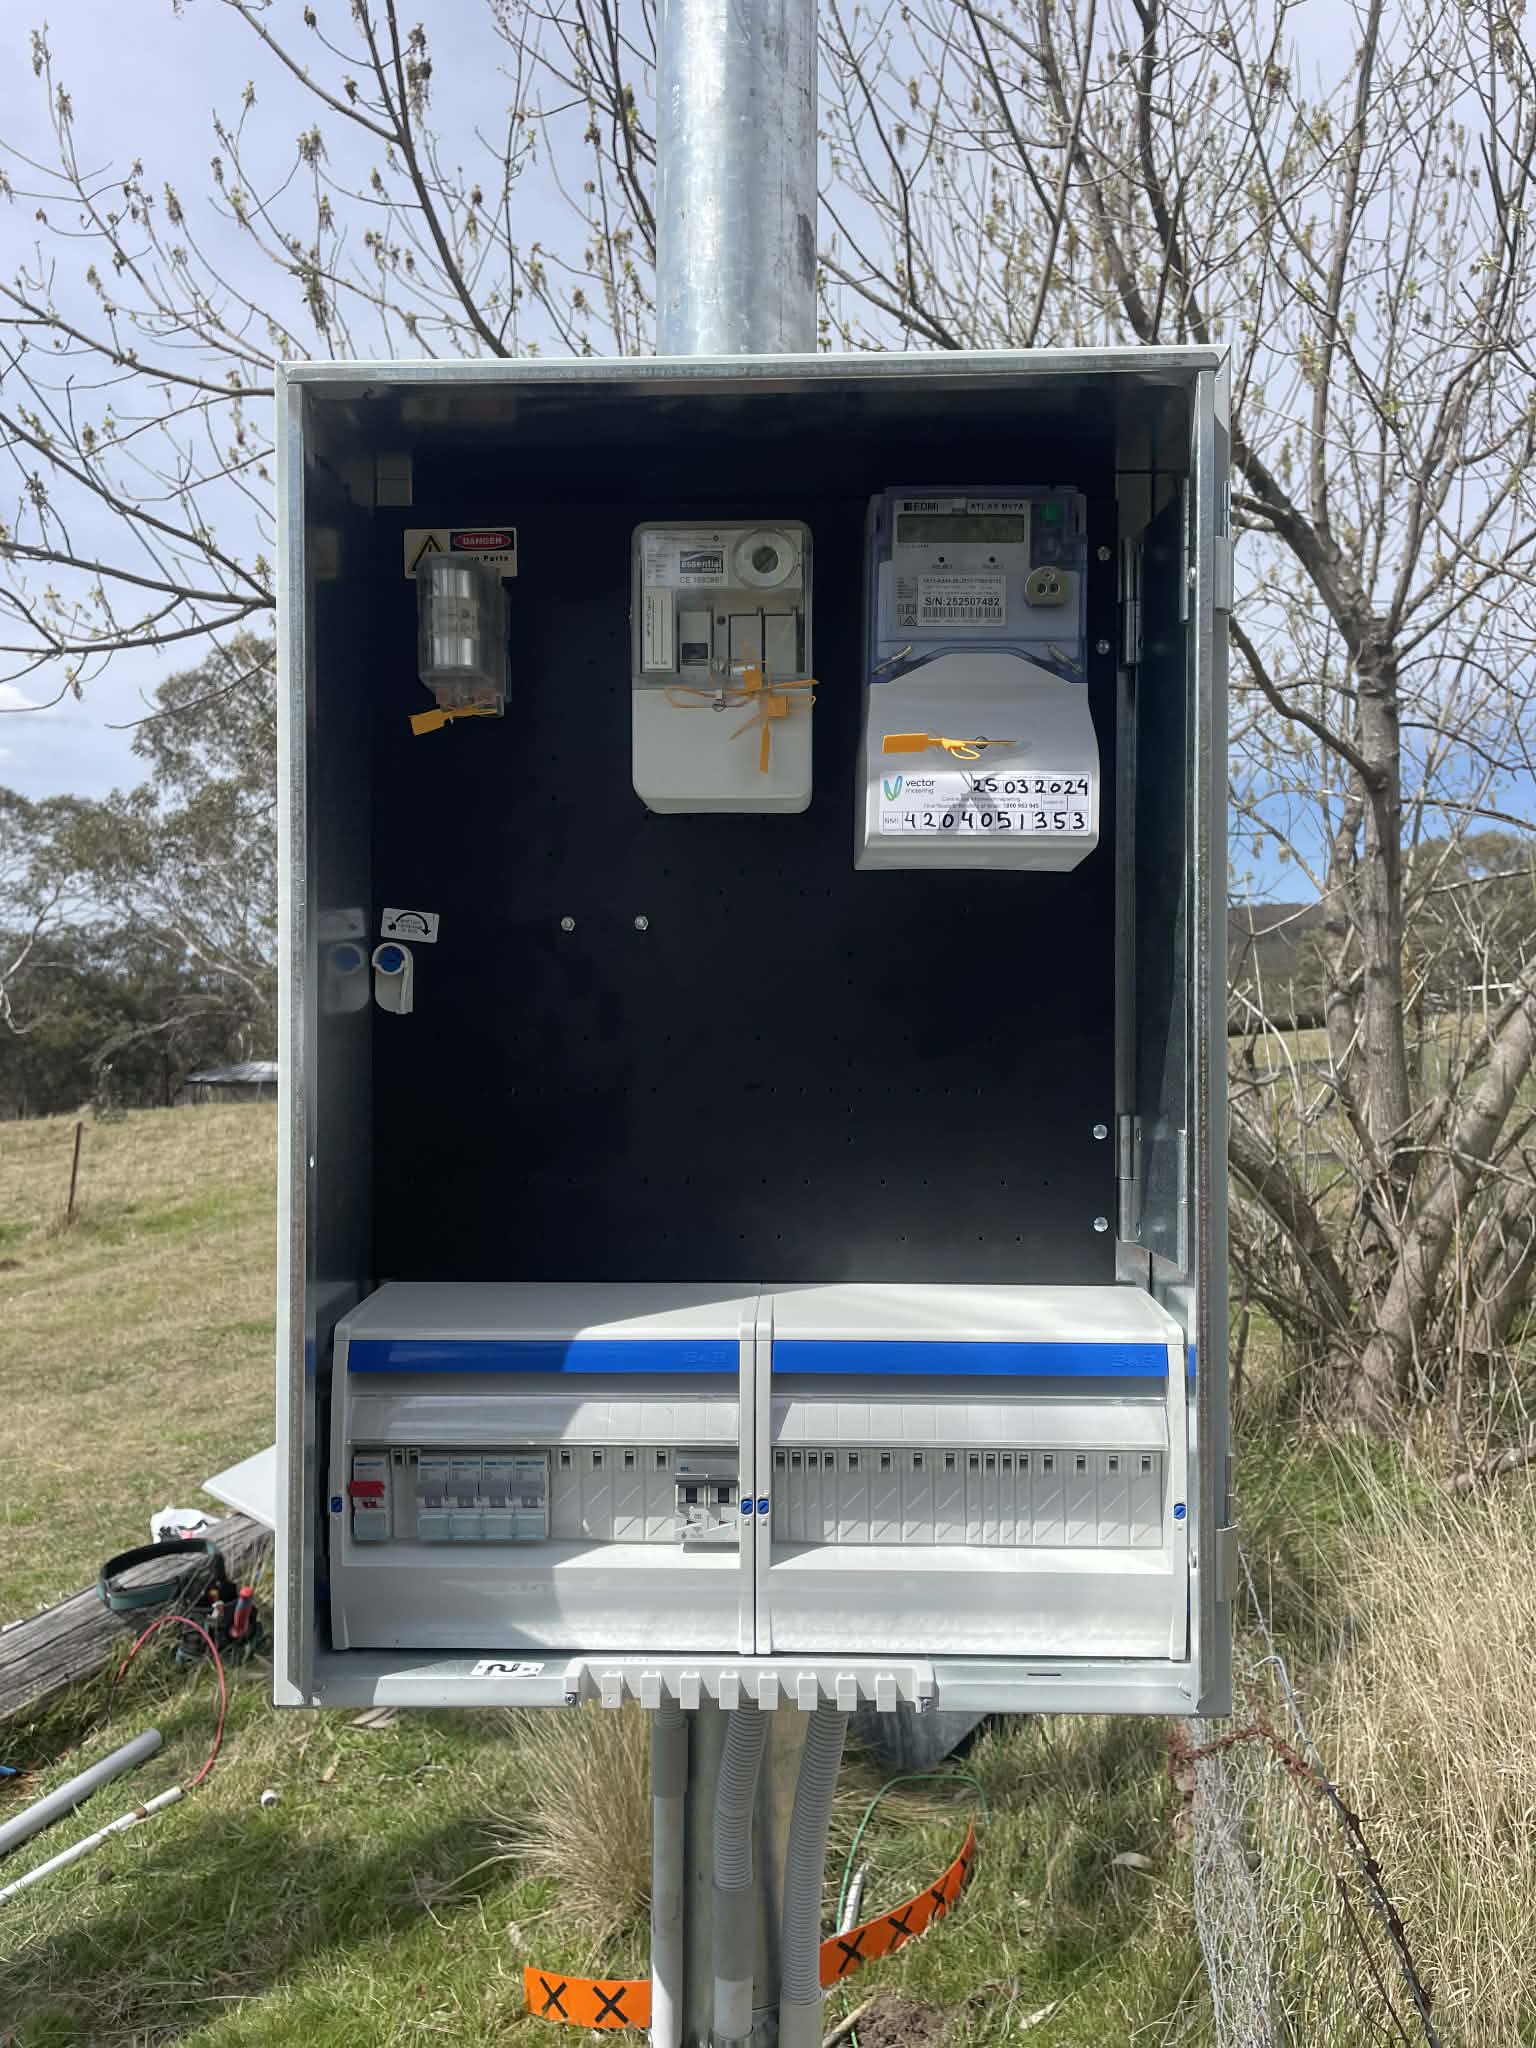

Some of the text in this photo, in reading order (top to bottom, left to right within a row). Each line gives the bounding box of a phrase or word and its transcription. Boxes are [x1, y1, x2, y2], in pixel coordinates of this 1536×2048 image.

[913, 502, 938, 512] EDMI
[463, 537, 503, 545] DANGER
[680, 558, 722, 569] essential
[905, 778, 937, 788] vector
